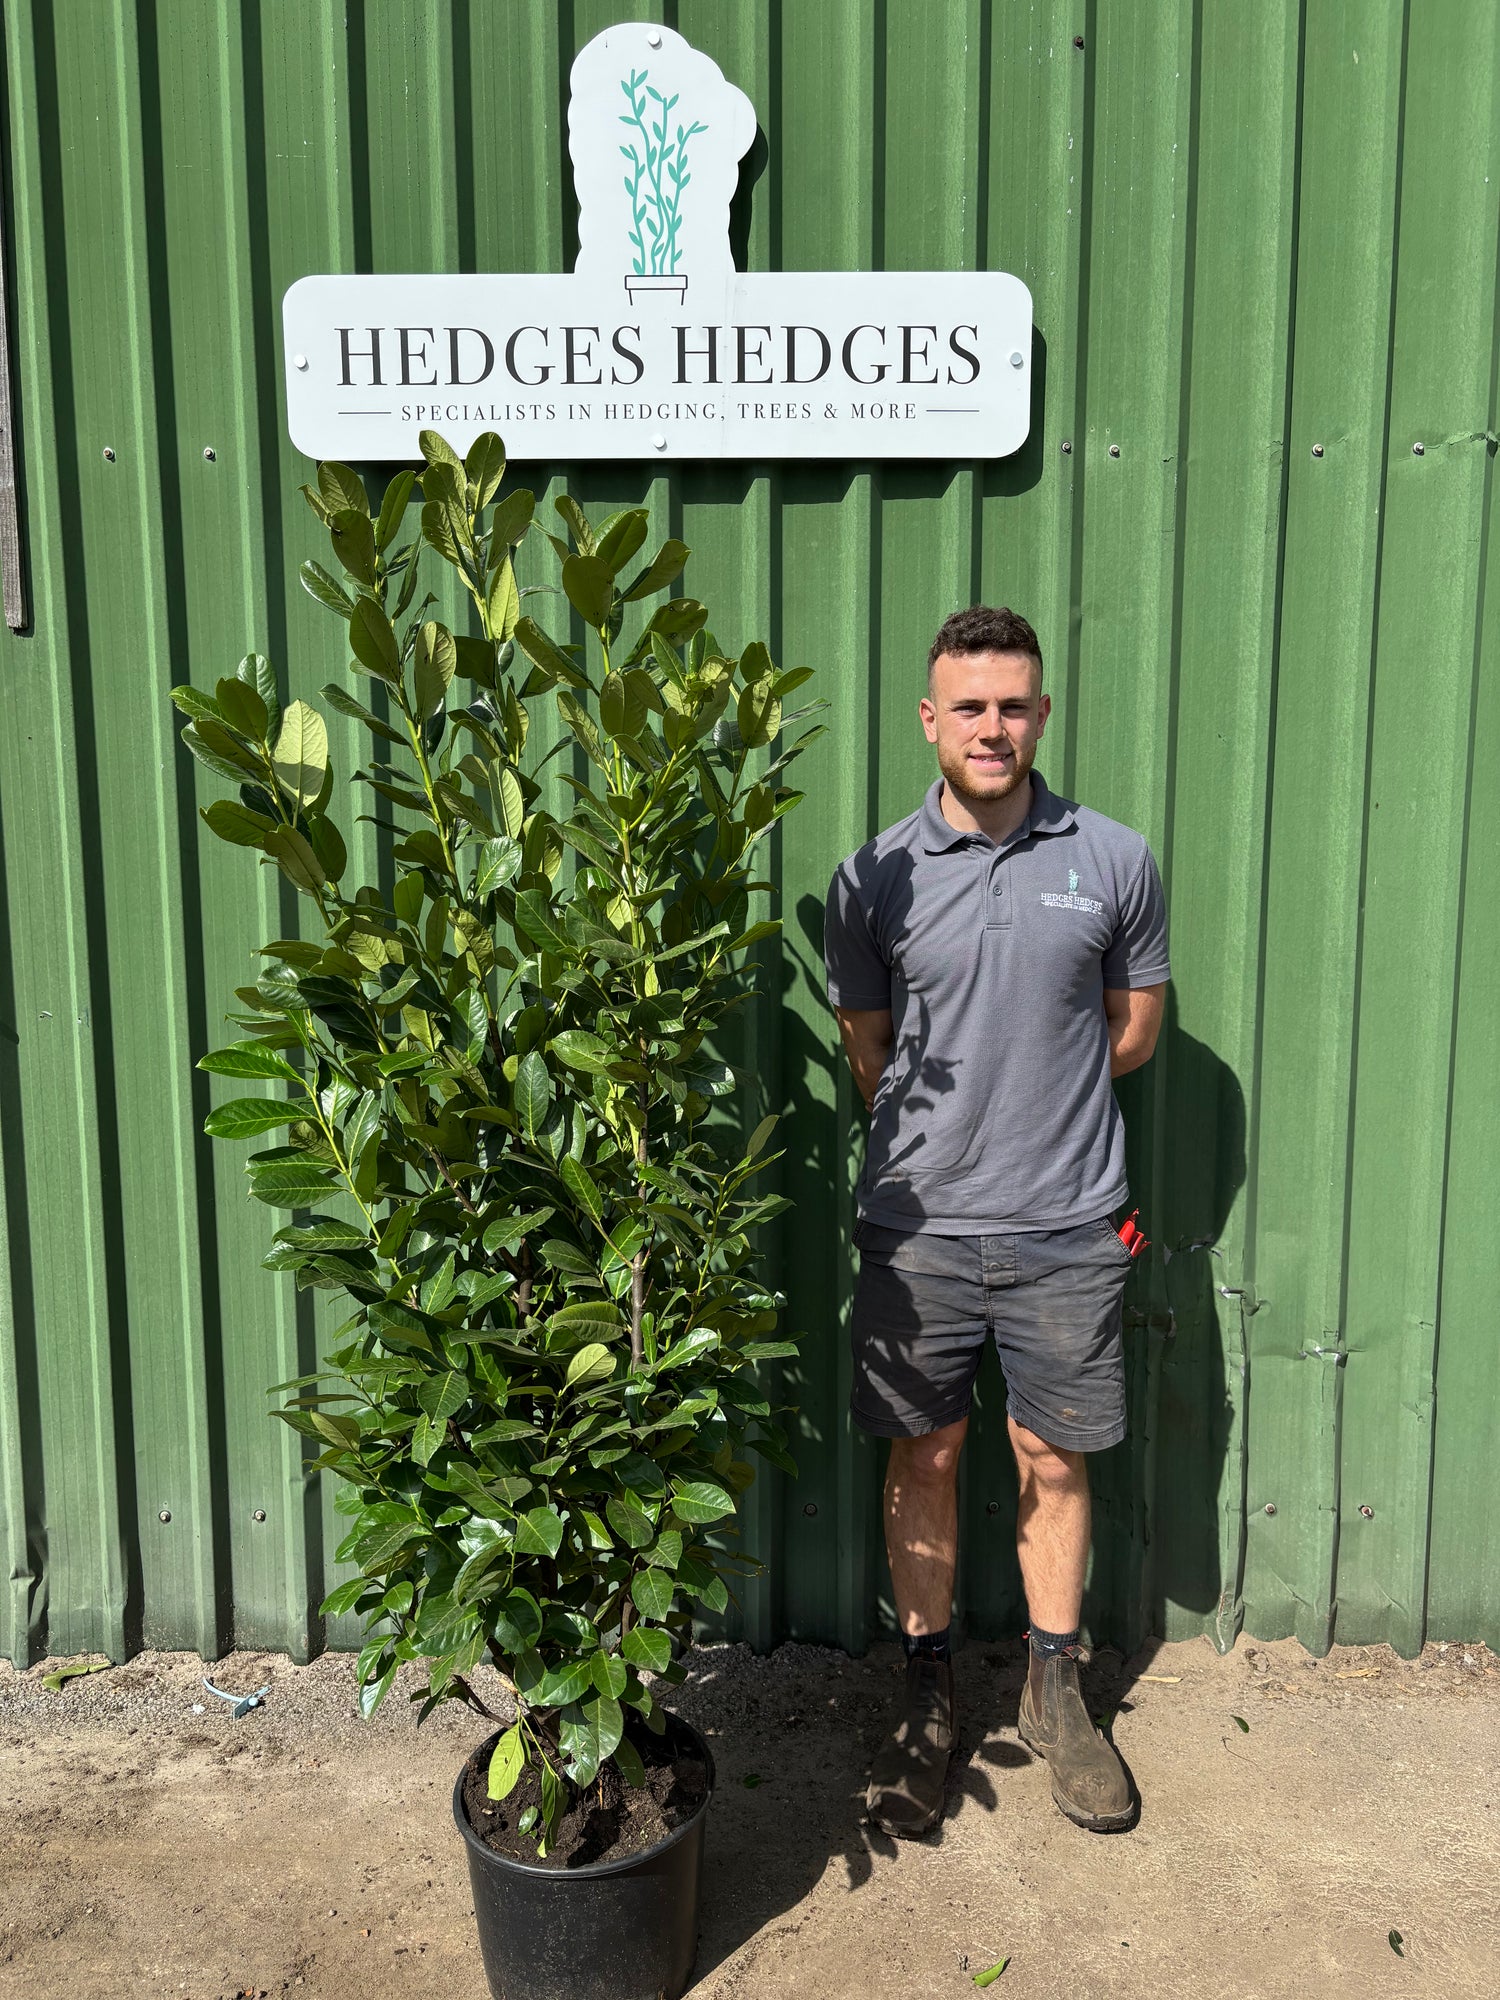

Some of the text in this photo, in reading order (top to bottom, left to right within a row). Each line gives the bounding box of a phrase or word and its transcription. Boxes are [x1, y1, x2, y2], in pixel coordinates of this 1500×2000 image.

[334, 324, 981, 386] HEDGES HEDGES
[401, 403, 917, 422] SPECIALISTS IN HEDGING, TREES & MORE
[1041, 893, 1103, 911] HEDGES HEDGES
